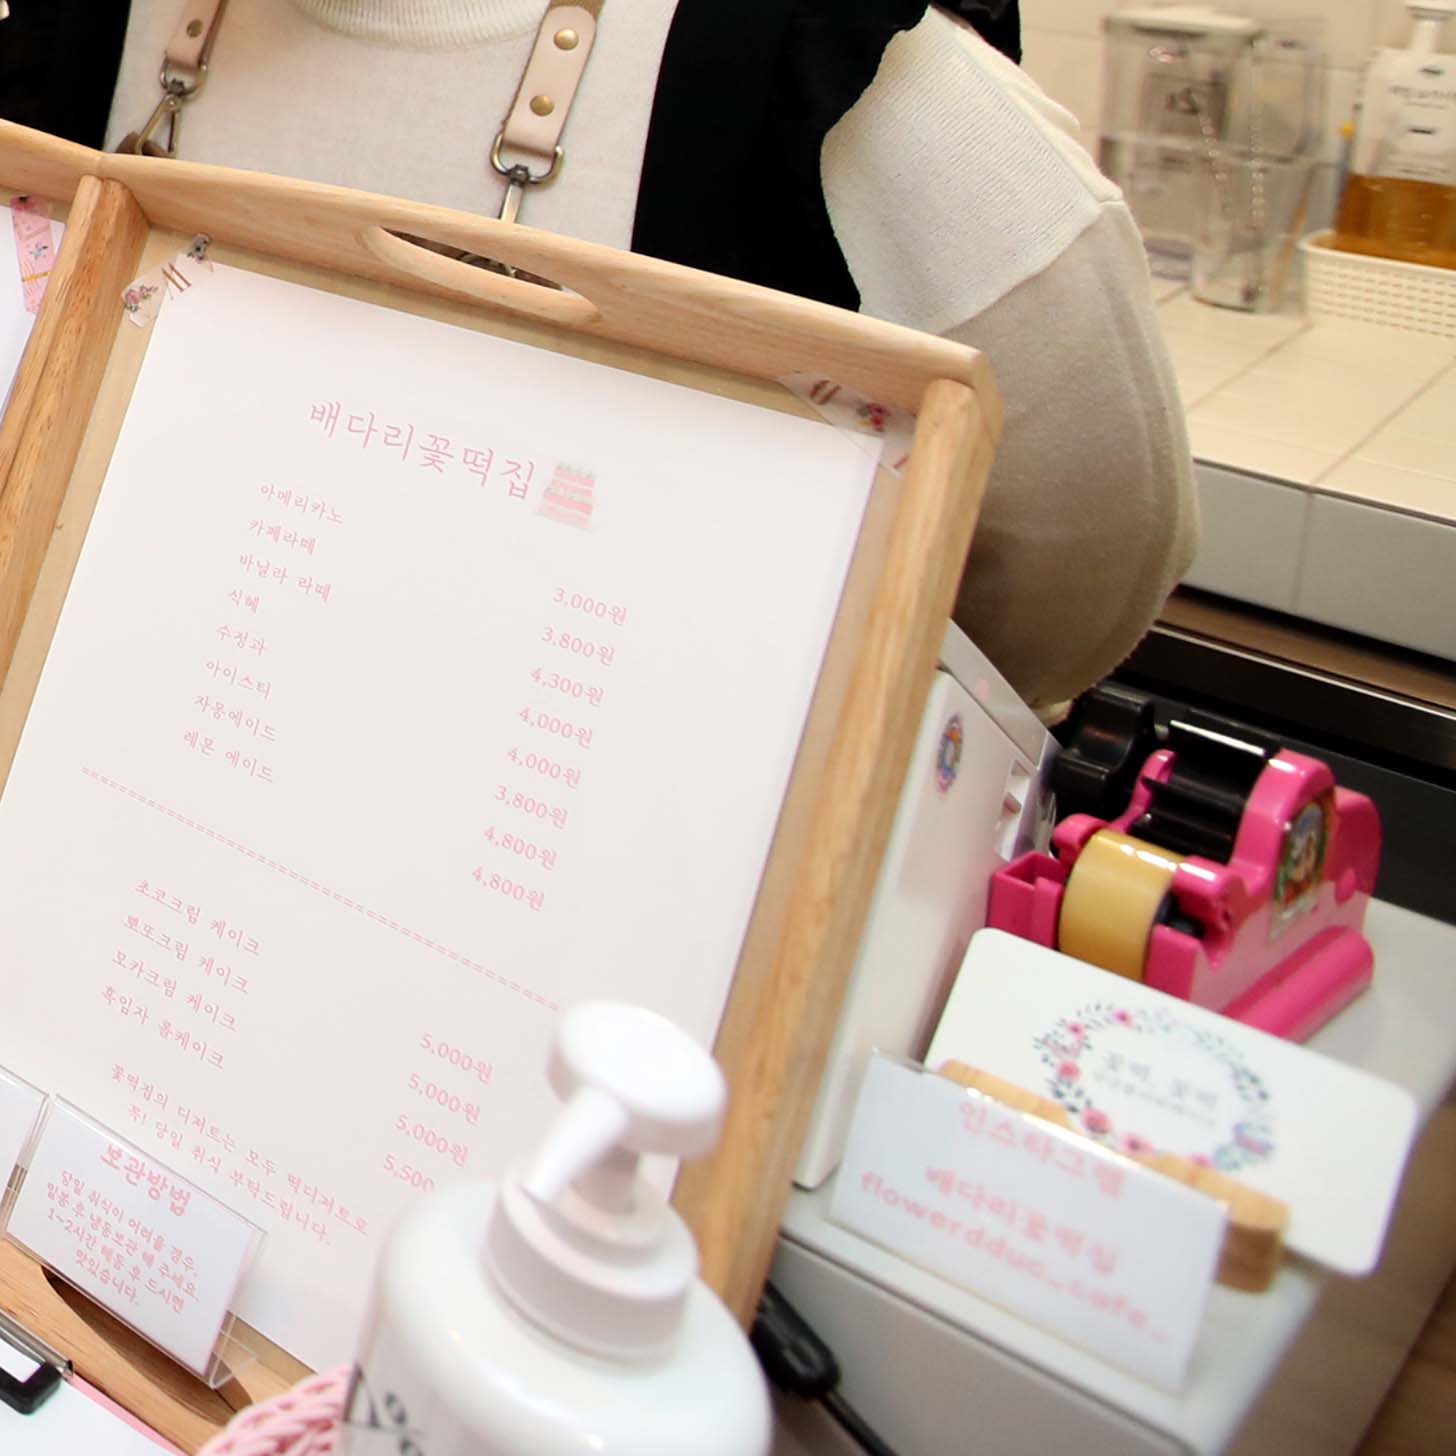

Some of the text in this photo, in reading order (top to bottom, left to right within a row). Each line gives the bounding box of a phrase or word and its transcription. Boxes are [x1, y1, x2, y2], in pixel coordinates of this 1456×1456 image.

[309, 401, 535, 500] 배다리꽃떡집
[260, 484, 344, 524] 아메리카노
[240, 554, 288, 584] 바닐라
[216, 624, 266, 656] 수정과
[206, 659, 272, 701] 아이스티
[194, 695, 278, 742] 자몽에이드
[184, 729, 273, 783] 레몬 에이드
[136, 879, 260, 956] 초코크림 케이크
[112, 950, 237, 1032] 모카크림 케이크
[198, 956, 249, 994] 케이크
[102, 984, 149, 1025] 흑임자
[245, 1149, 278, 1176] 모두
[384, 1153, 436, 1193] 5,500
[959, 1100, 1126, 1200] 인스타그램
[61, 1169, 85, 1192] 당일
[88, 1187, 124, 1219] 취식이
[100, 1144, 192, 1215] 보관방법
[74, 1199, 85, 1217] 후
[89, 1208, 138, 1255] 냉동보관
[47, 1207, 99, 1250] 1~2시간
[129, 1266, 141, 1284] 후
[143, 1278, 185, 1312] 드시면
